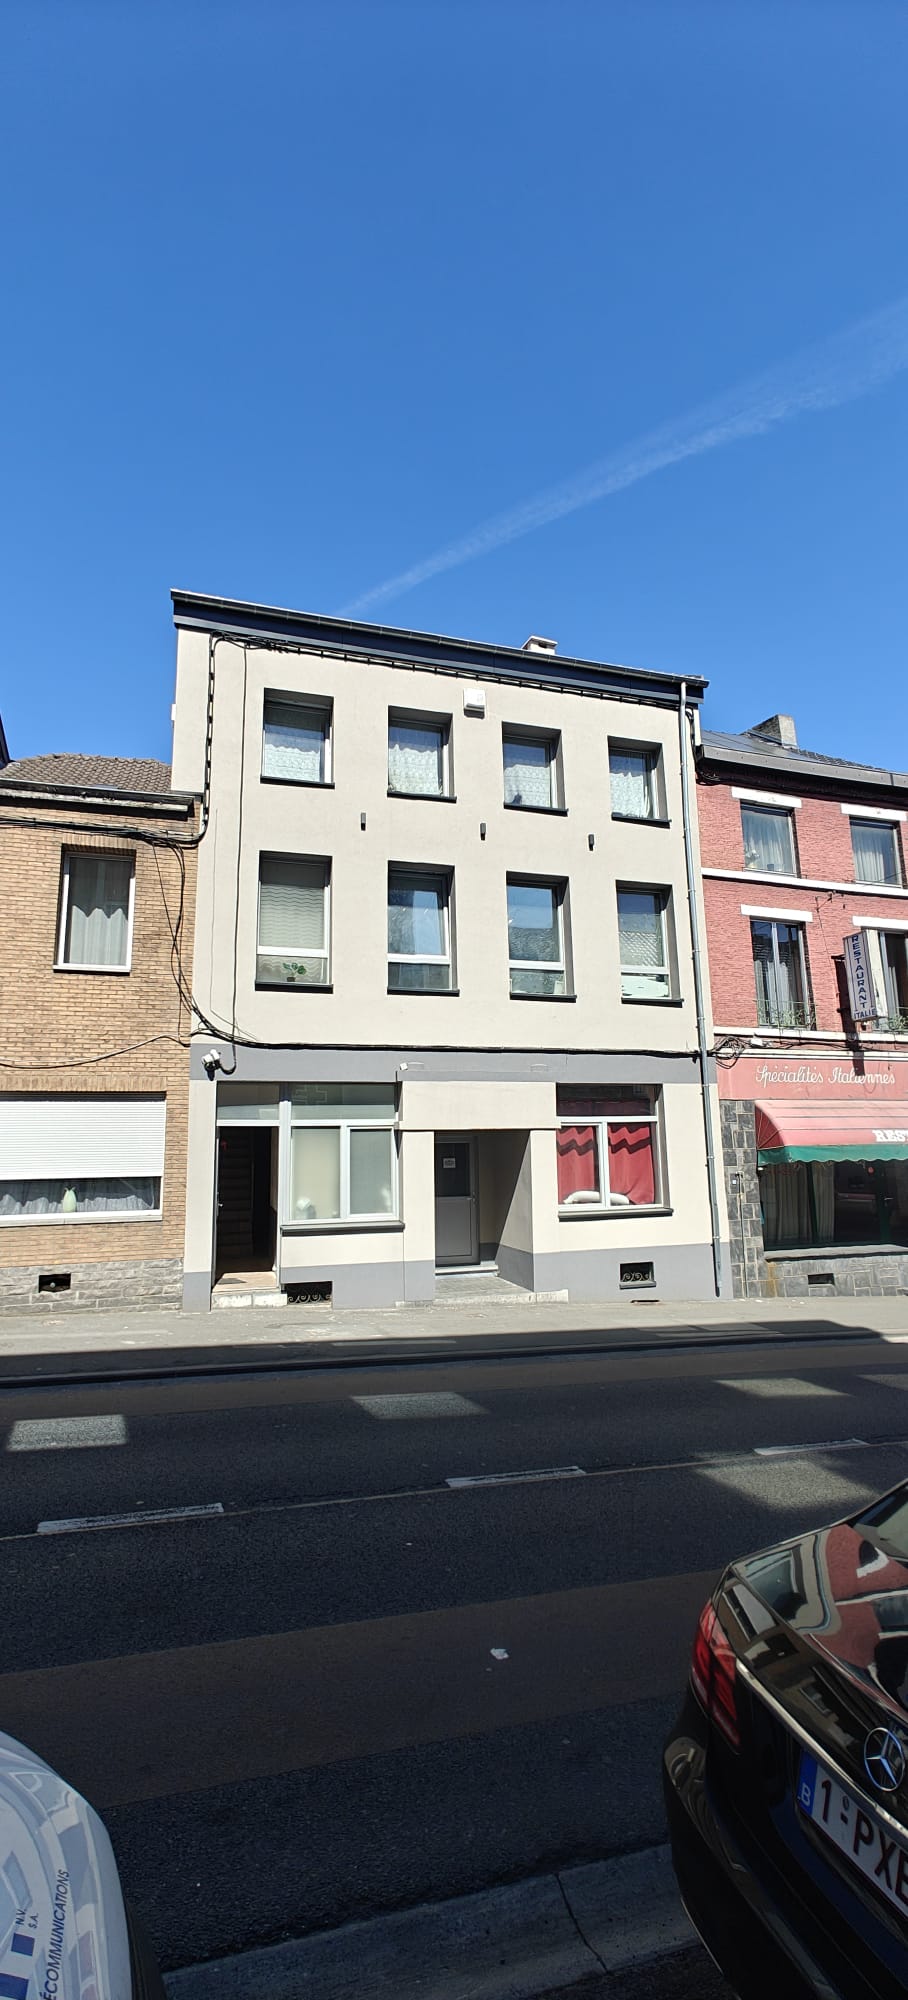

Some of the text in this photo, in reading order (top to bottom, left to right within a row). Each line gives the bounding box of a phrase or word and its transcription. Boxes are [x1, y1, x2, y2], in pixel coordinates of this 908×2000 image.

[851, 935, 867, 1008] RESTAURANT
[755, 1064, 895, 1088] Spécialités Italiennes
[801, 1782, 811, 1807] B
[16, 1908, 27, 1925] N.V.
[28, 1912, 39, 1929] S.A.
